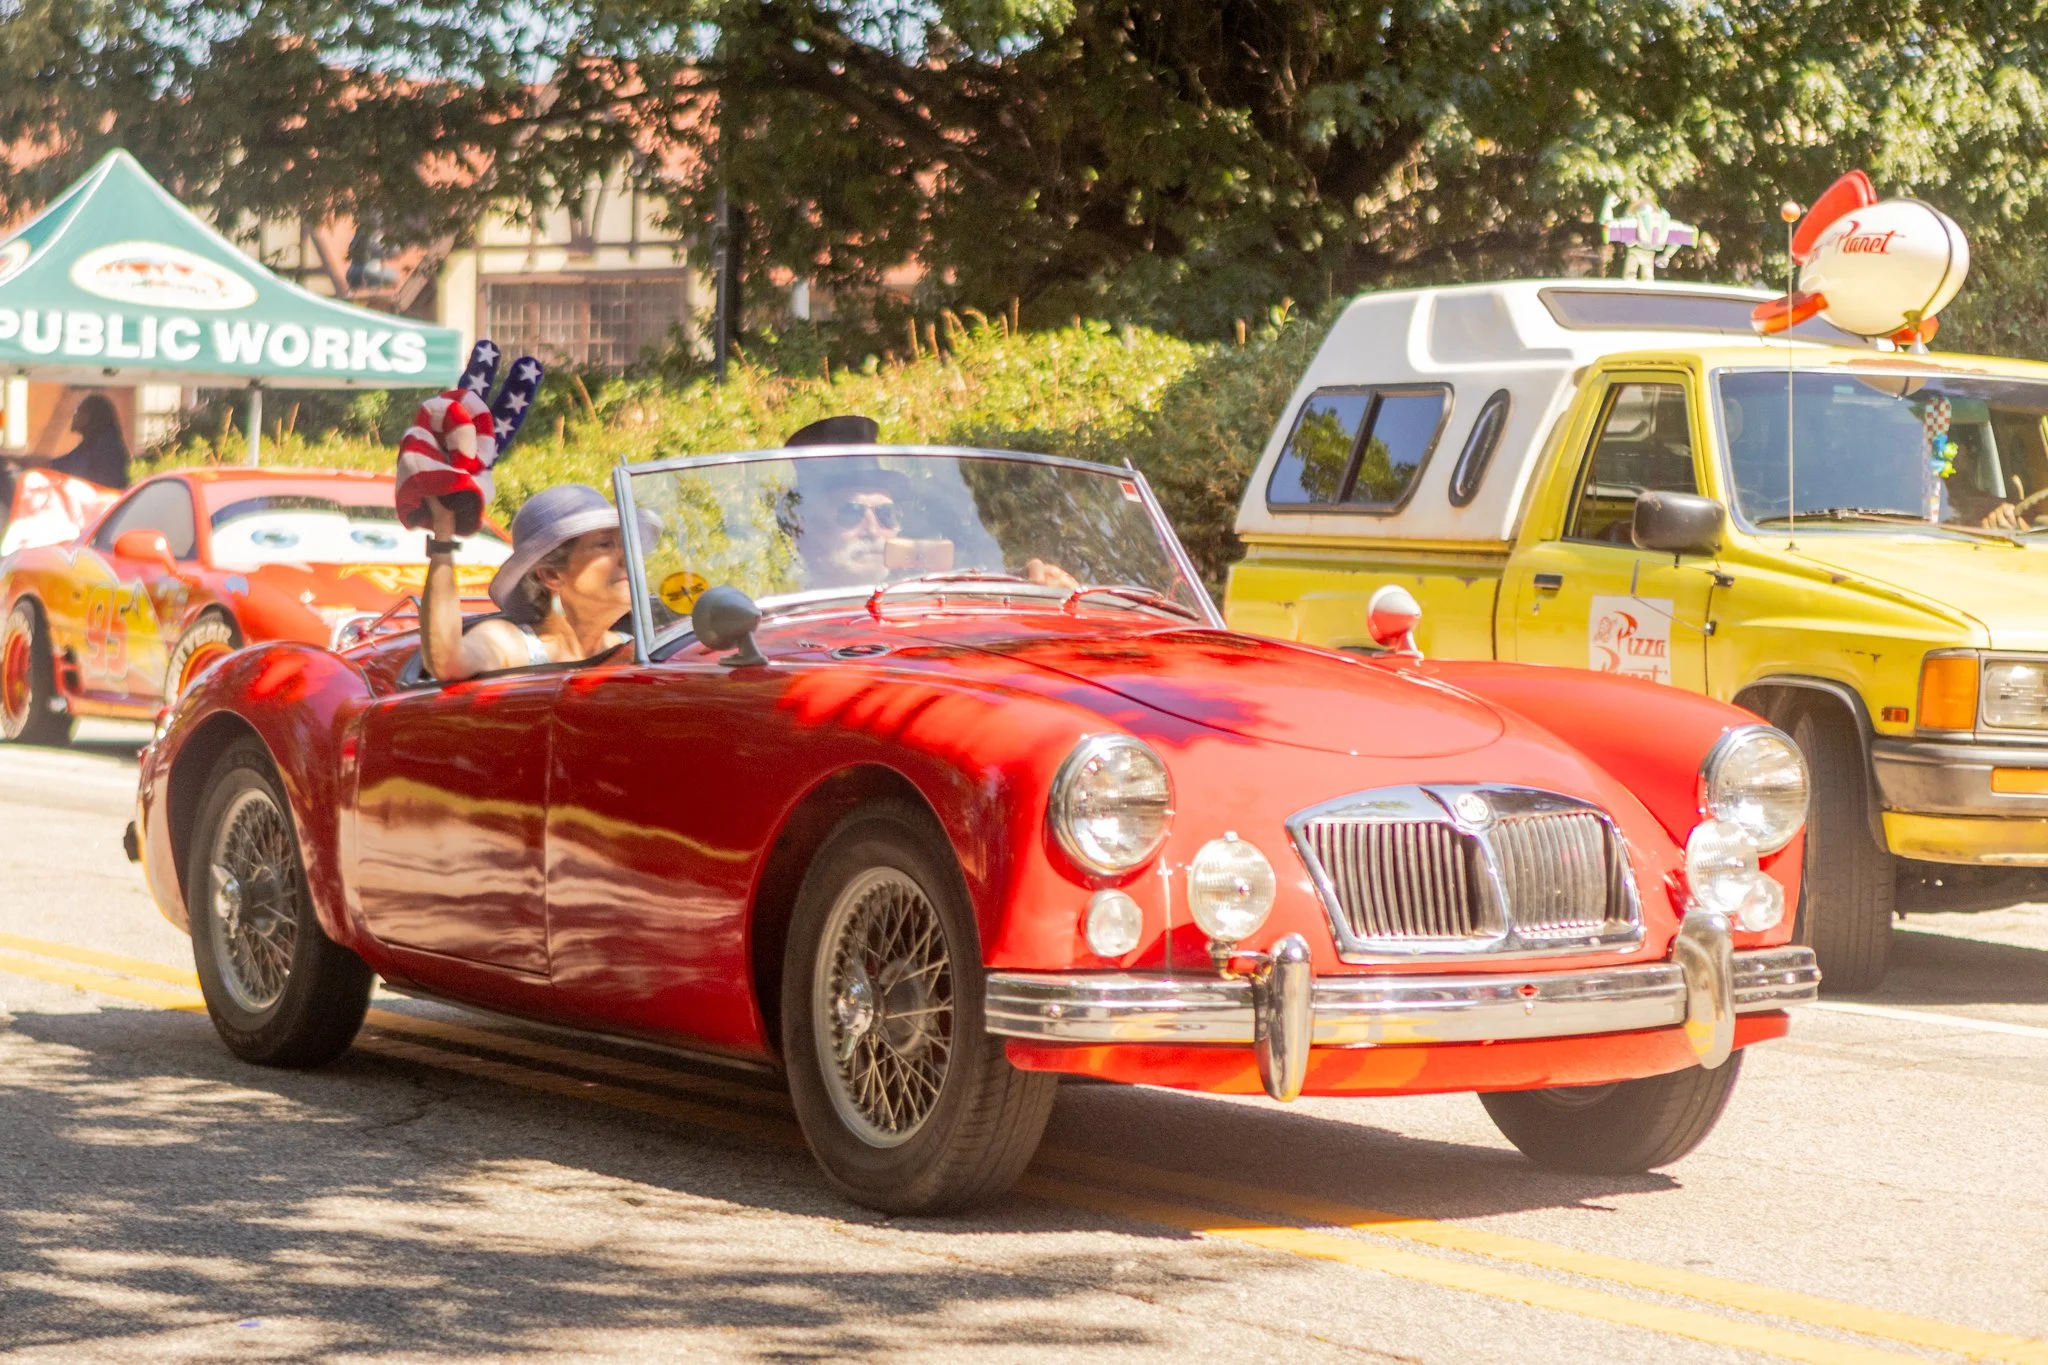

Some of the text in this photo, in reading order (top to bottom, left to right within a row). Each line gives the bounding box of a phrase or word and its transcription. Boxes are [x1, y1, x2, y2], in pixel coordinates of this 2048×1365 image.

[0, 308, 428, 374] PUBLIC WORKS
[87, 584, 129, 680] 95
